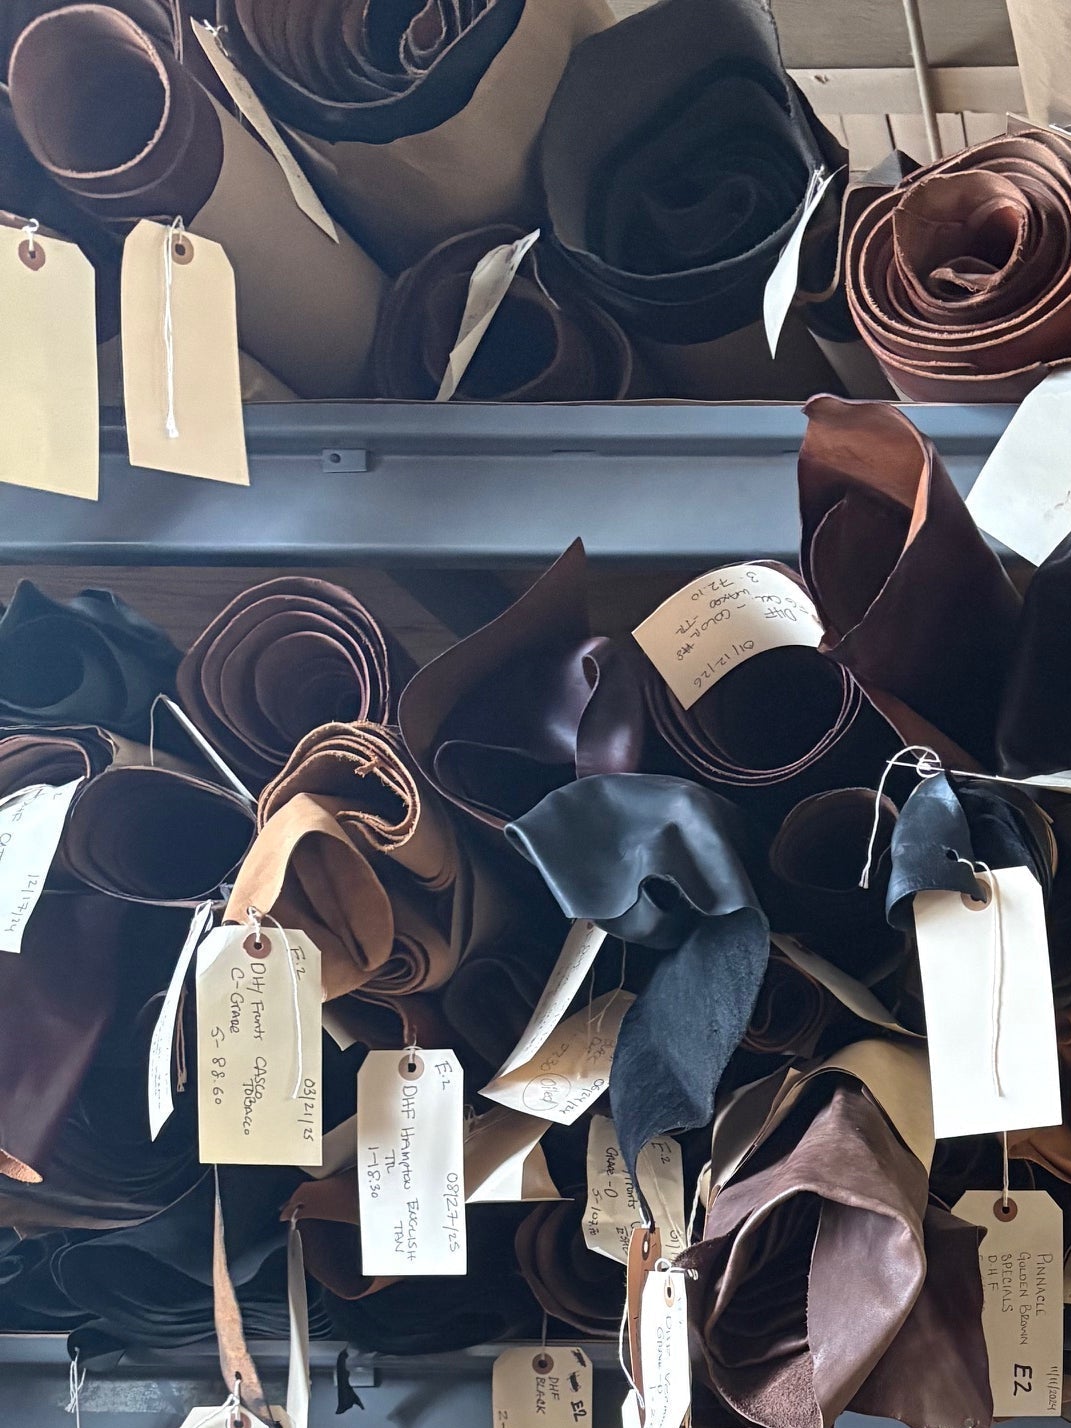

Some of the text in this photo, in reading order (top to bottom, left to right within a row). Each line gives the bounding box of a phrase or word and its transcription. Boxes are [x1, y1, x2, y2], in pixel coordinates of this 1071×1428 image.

[401, 1085, 416, 1118] DHF
[1001, 1254, 1012, 1313] SPECIALS
[1035, 1253, 1052, 1316] PINNACLE
[1013, 1252, 1032, 1396] GOLDEN BROWN E2
[535, 1376, 545, 1414] BLACK
[547, 1376, 559, 1400] DHF
[570, 1400, 586, 1421] E2
